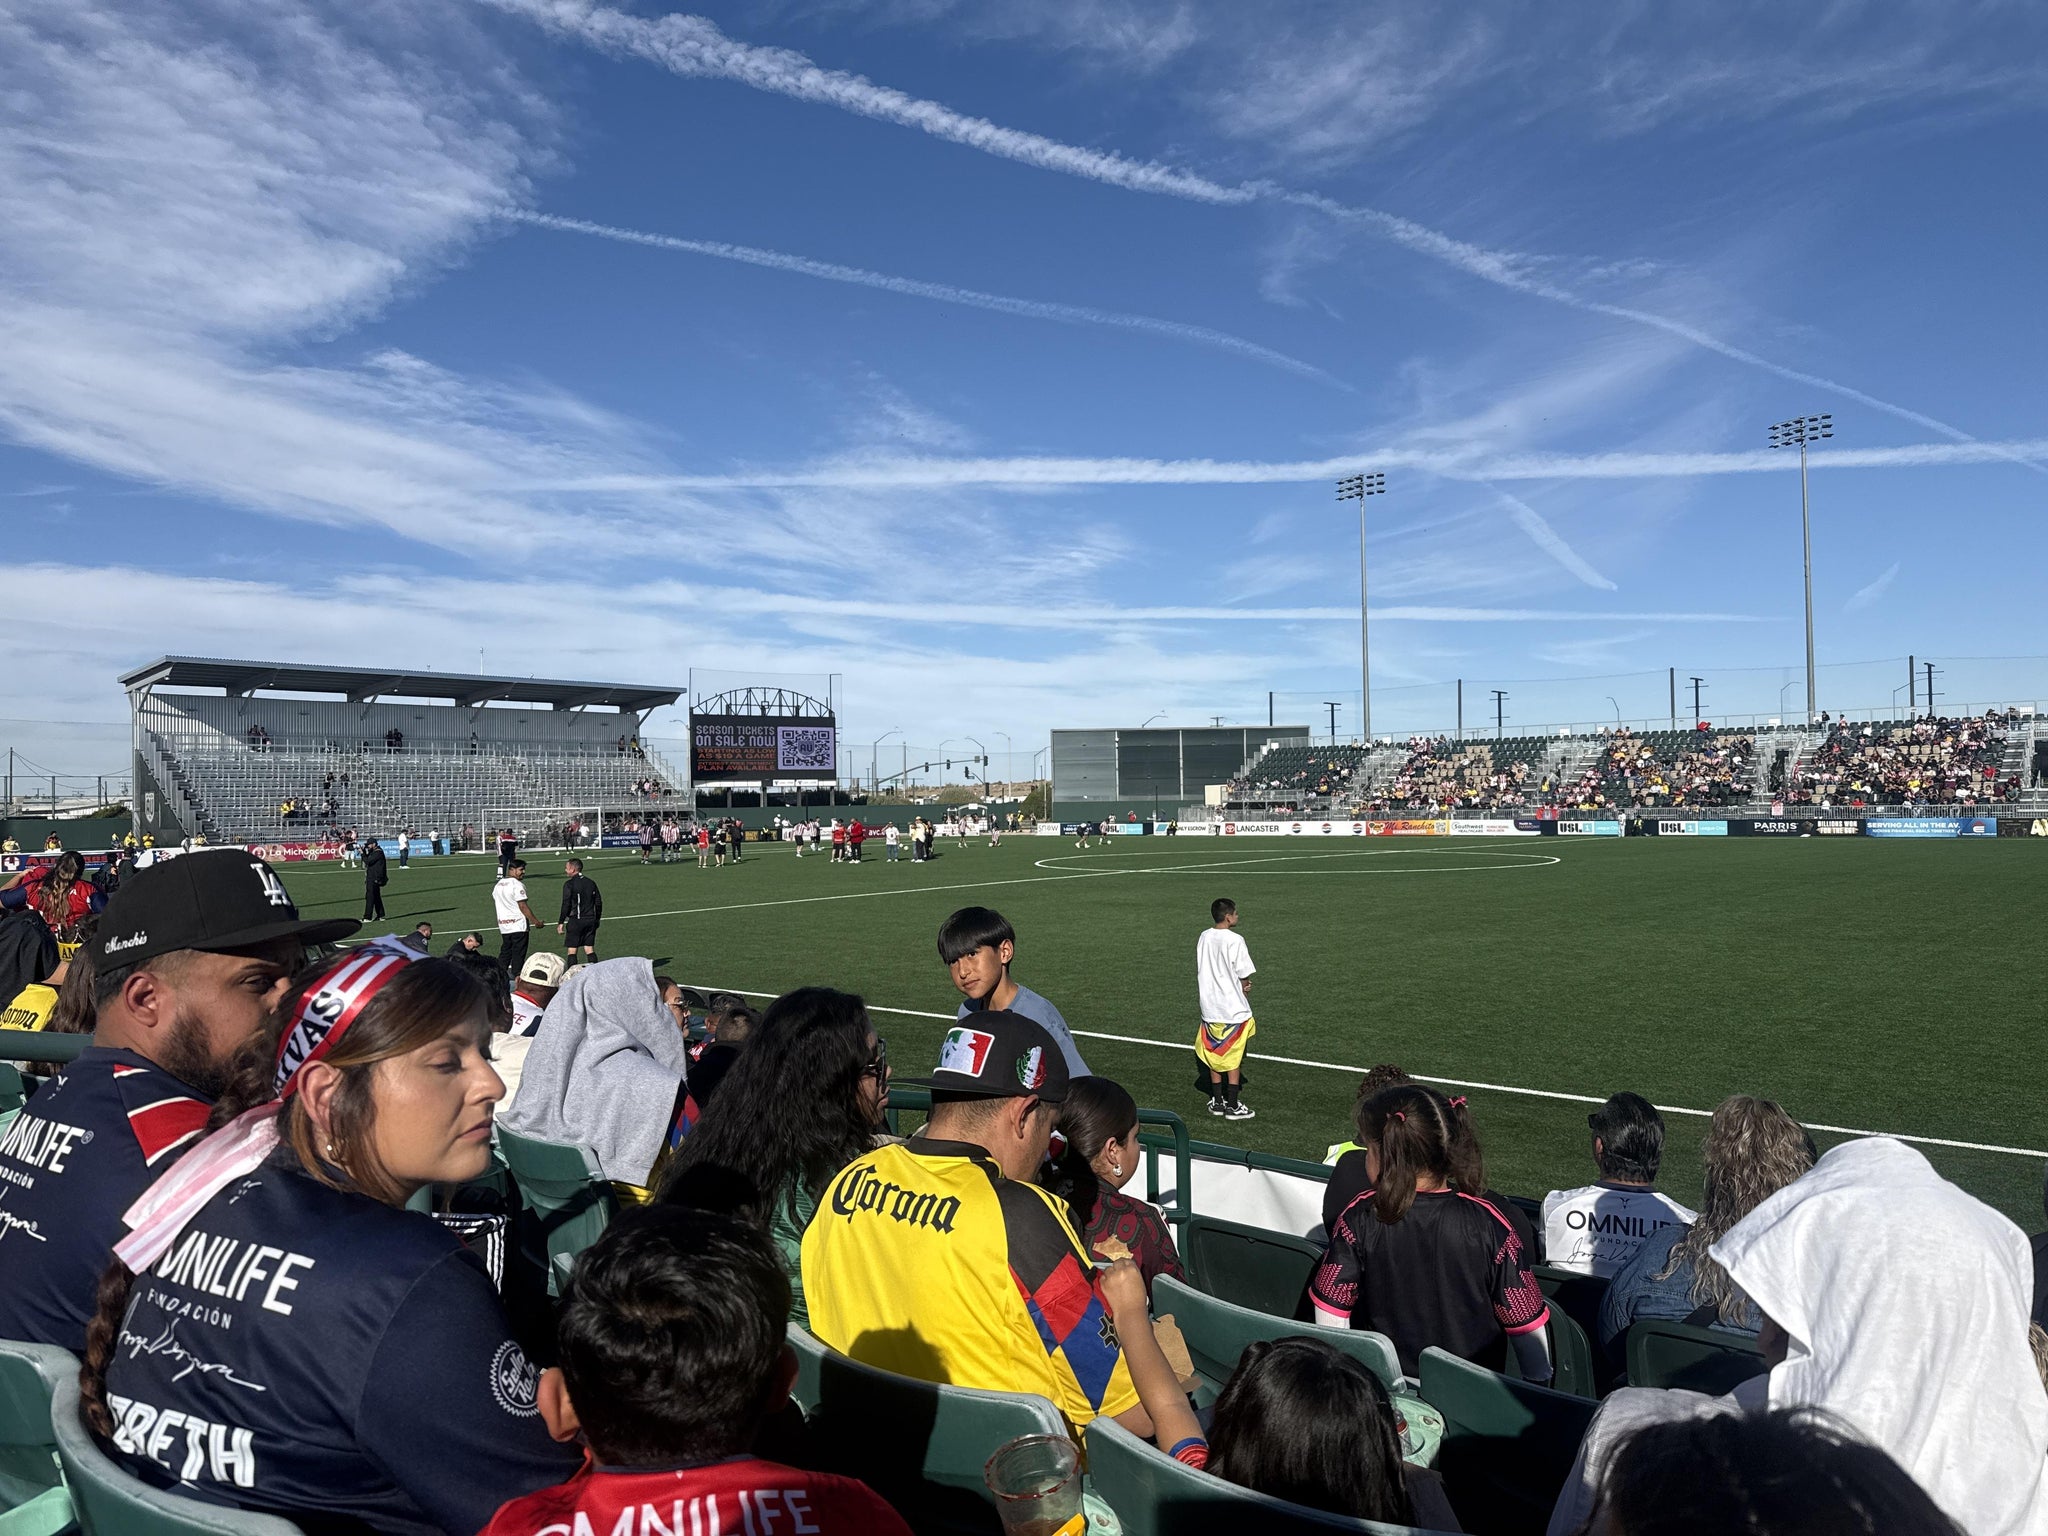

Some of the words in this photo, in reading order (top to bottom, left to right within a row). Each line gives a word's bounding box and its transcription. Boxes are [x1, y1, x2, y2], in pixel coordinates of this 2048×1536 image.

[696, 725, 734, 735] SEASON
[736, 726, 775, 736] TICKETS
[696, 735, 712, 746] ON
[716, 736, 745, 746] SALE
[750, 736, 776, 746] NOW
[1401, 822, 1434, 830] Ranchito
[284, 848, 336, 856] Michoacana
[250, 863, 290, 906] LA
[832, 1162, 962, 1234] Corona
